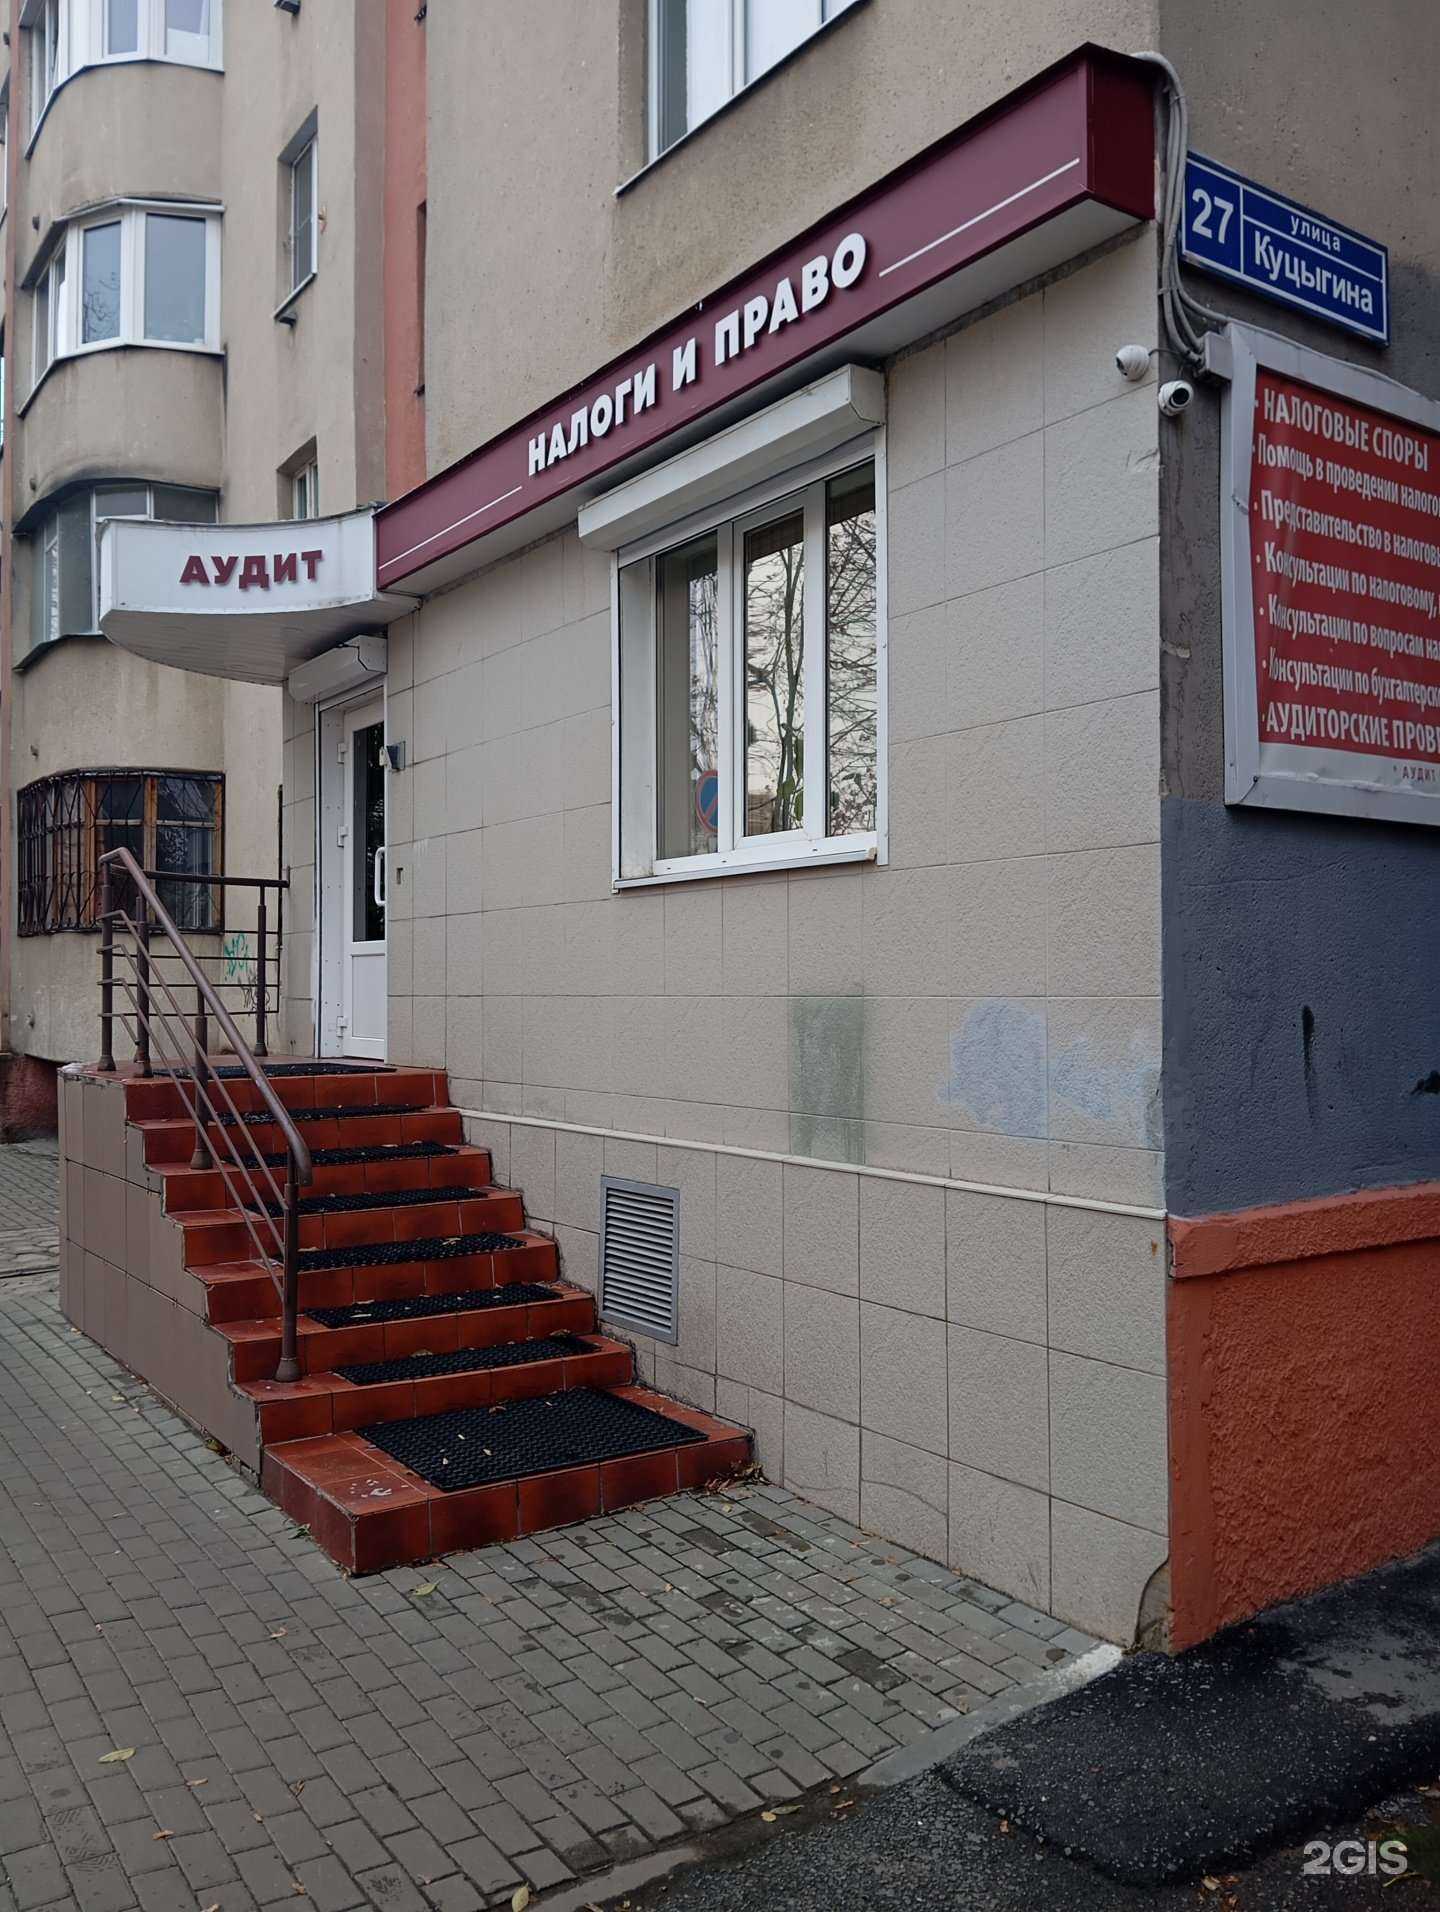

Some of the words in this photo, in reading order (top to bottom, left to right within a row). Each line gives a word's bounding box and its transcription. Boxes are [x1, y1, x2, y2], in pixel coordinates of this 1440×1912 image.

[1191, 187, 1234, 244] 27
[1290, 214, 1341, 252] улица
[1254, 230, 1374, 315] Куцыгина
[528, 363, 656, 477] НАЛОГИ
[672, 337, 697, 392] И
[714, 232, 867, 367] ПРАВО
[1263, 387, 1369, 452] НАЛОГОВЫЕ
[1372, 426, 1428, 472] СПОРЫ
[1257, 432, 1314, 482] Помощь
[1315, 457, 1324, 481] в
[1326, 460, 1399, 505] проведении
[1260, 489, 1382, 551] Представительство
[1383, 530, 1391, 553] в
[179, 549, 323, 590] АУДИТ
[1264, 541, 1350, 594] Консультации
[1351, 571, 1367, 596] по
[1268, 593, 1352, 645] Консультации
[1353, 620, 1368, 645] по
[1369, 624, 1425, 660] вопросам
[1269, 646, 1353, 695] Консультации
[1354, 671, 1370, 696] по
[1266, 701, 1390, 748] АУДИТОРСКИЕ
